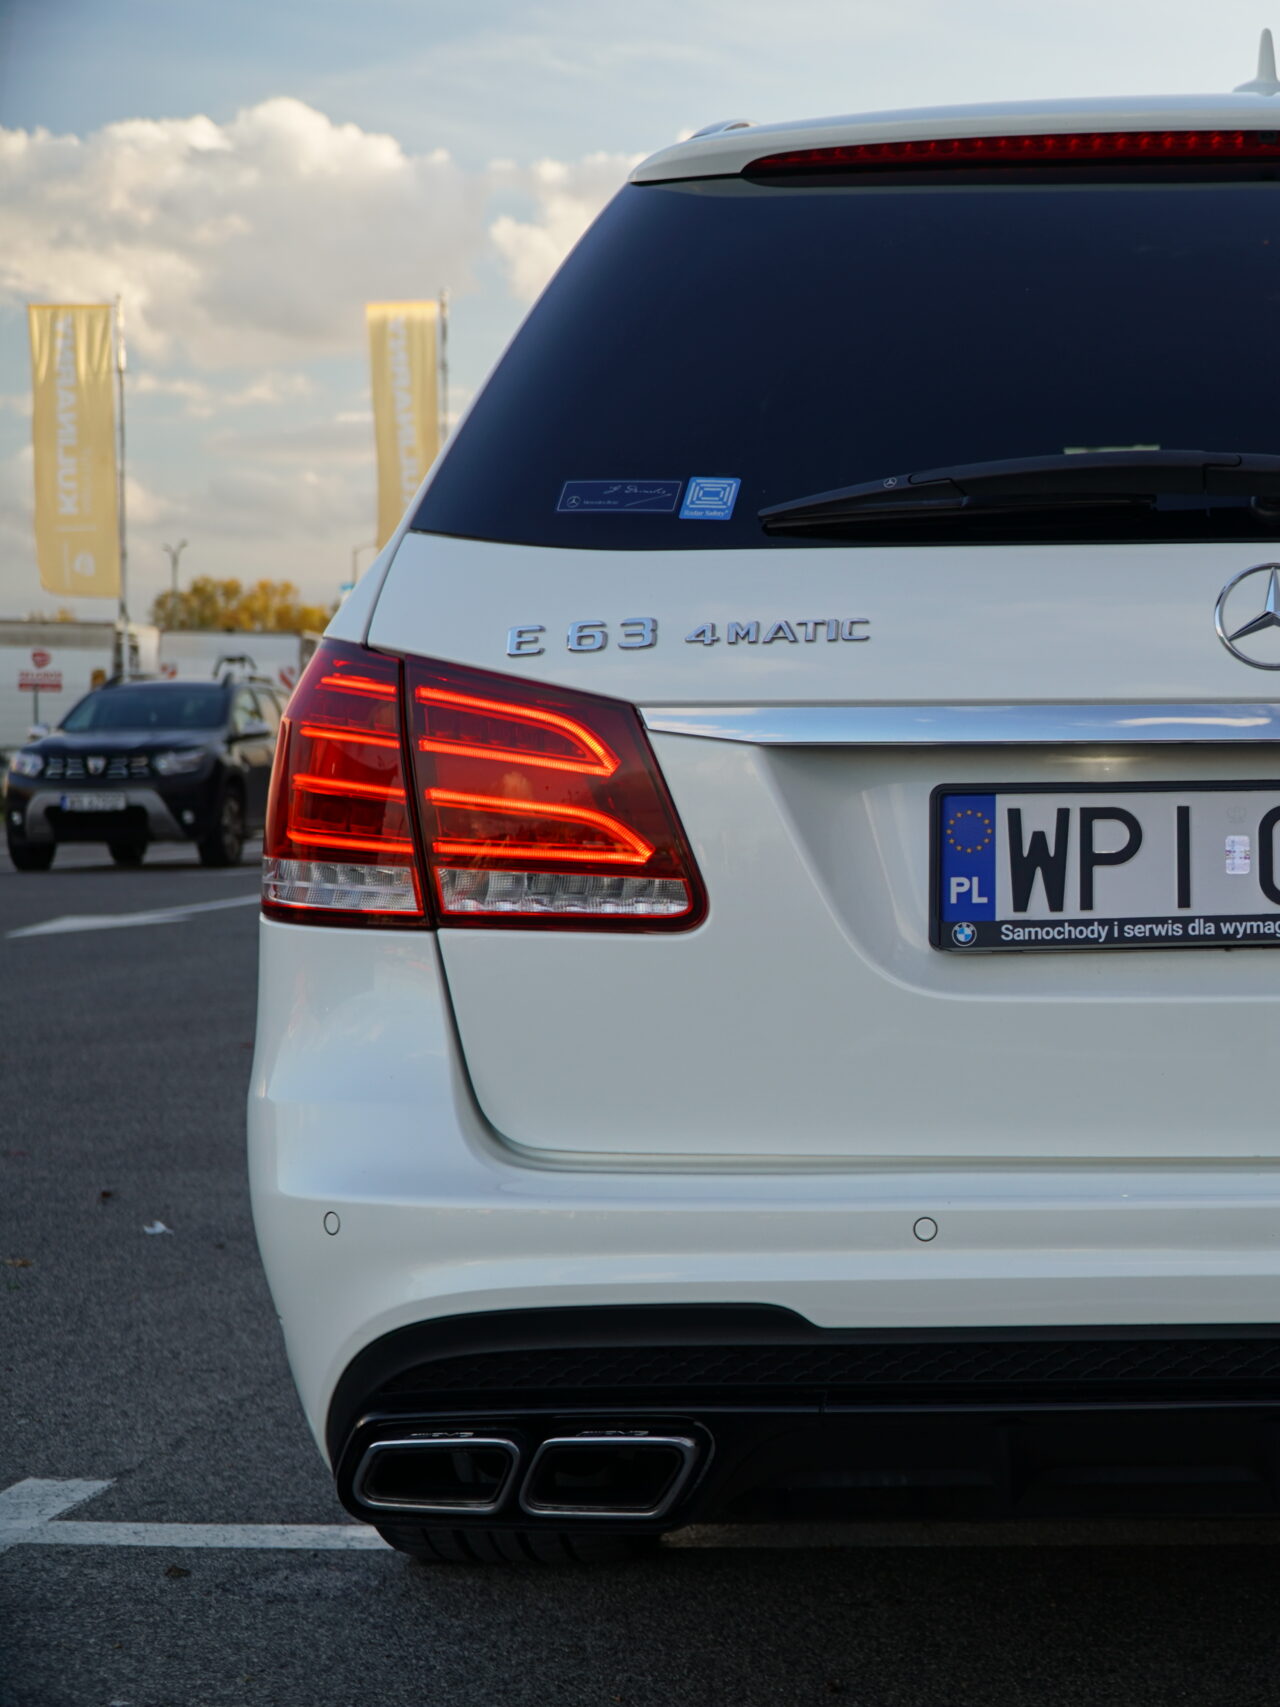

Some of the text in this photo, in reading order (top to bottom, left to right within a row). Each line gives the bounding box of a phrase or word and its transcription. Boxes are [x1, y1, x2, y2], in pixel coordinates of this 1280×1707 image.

[506, 617, 871, 657] E 63 4MATIC
[949, 876, 989, 905] PL
[1000, 922, 1109, 941] Samochody
[1113, 922, 1119, 938] i
[1123, 919, 1183, 937] serwis
[1188, 919, 1216, 936] dla
